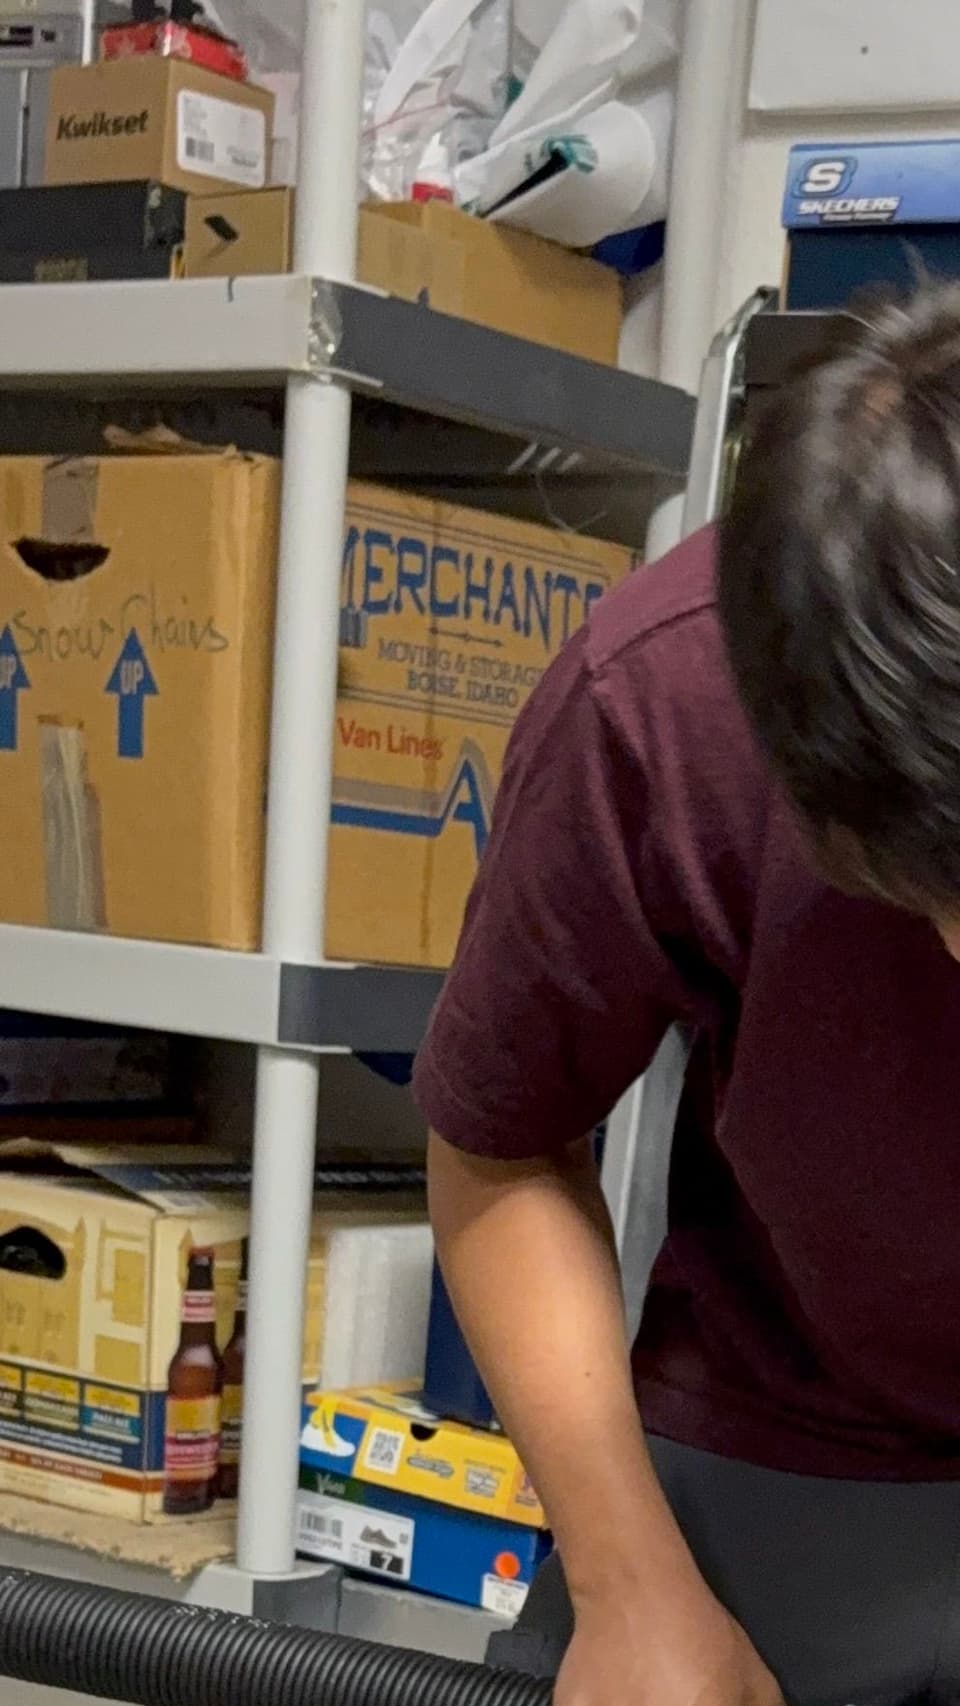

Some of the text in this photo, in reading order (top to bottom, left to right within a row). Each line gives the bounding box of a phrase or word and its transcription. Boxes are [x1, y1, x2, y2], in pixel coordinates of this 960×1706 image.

[56, 109, 150, 141] Kwikset
[796, 196, 901, 215] SKECHERS
[12, 591, 229, 662] Snow Chains
[120, 659, 144, 695] UP
[377, 637, 450, 672] MOVING
[469, 655, 545, 688] STORAG
[466, 681, 519, 708] IDAHO
[336, 717, 443, 760] Van Lines
[380, 1554, 393, 1571] 7
